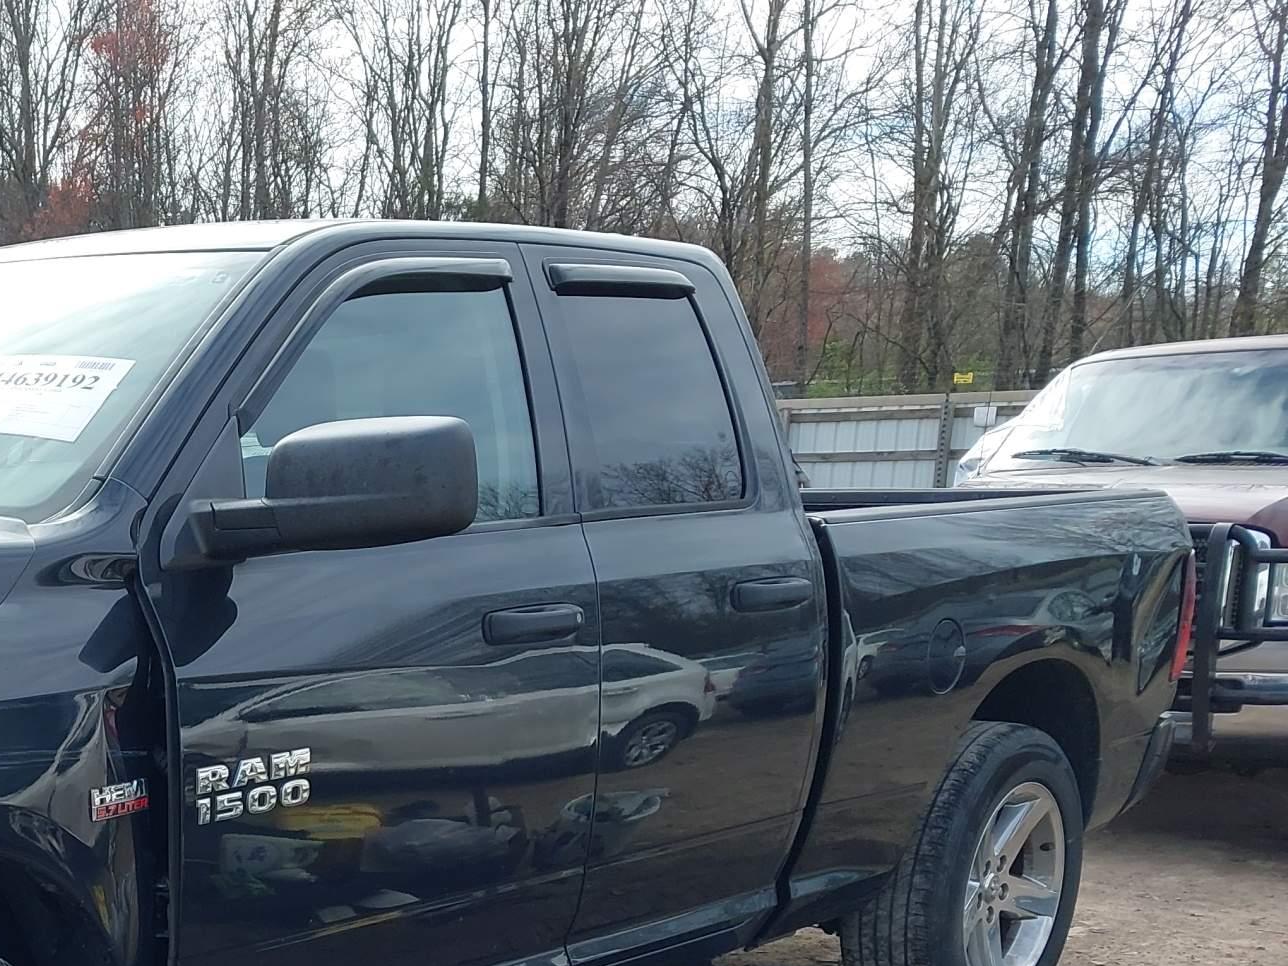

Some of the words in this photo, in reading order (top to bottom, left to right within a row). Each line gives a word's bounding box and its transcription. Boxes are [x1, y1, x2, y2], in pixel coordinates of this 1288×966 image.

[196, 748, 311, 795] RAM
[91, 778, 146, 806] HEMI
[97, 803, 117, 818] 5.7
[118, 796, 149, 814] LITER
[197, 778, 311, 825] 1500
